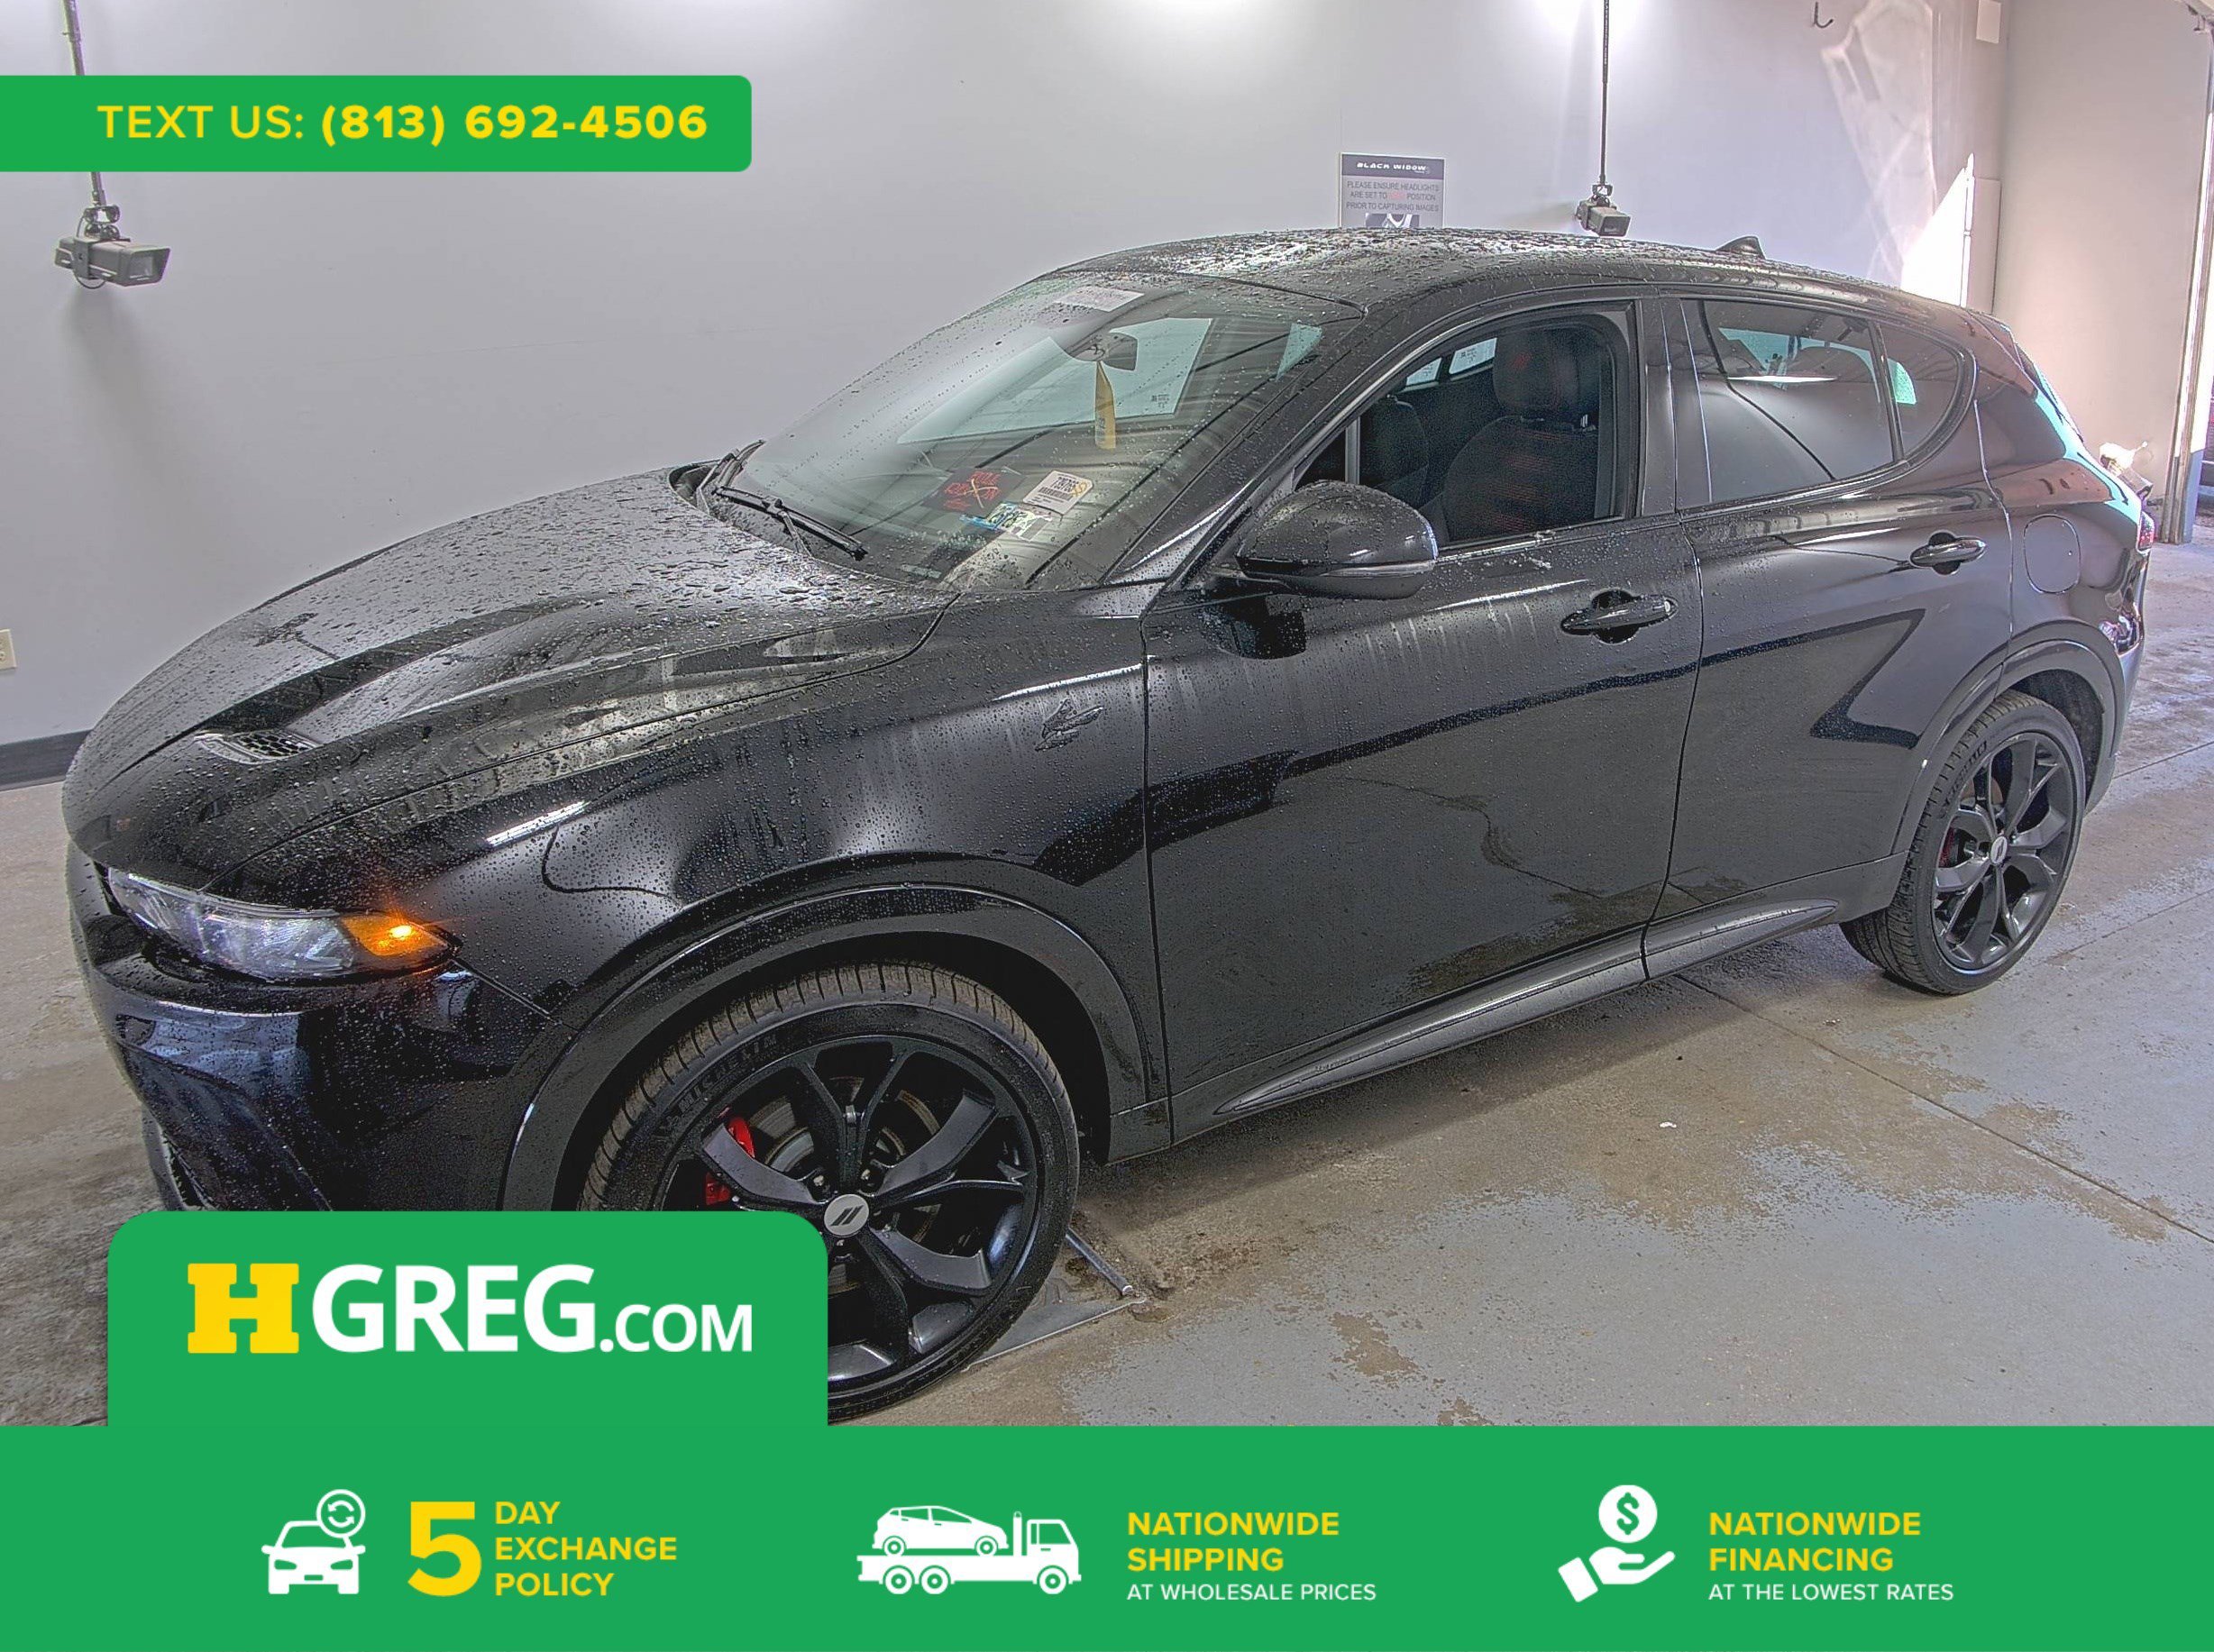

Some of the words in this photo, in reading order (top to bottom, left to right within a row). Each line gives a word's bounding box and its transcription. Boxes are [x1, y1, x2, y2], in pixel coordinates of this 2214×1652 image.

[1347, 180, 1373, 188] PLEASE
[1374, 181, 1399, 190] ENSURE
[1401, 182, 1440, 192] HEADLIGHTS
[1407, 193, 1436, 201] POSITION
[1346, 201, 1367, 210] PRIOR
[1368, 202, 1377, 210] TO
[1377, 203, 1414, 211] CAPTURING
[1415, 204, 1440, 212] IMAGES
